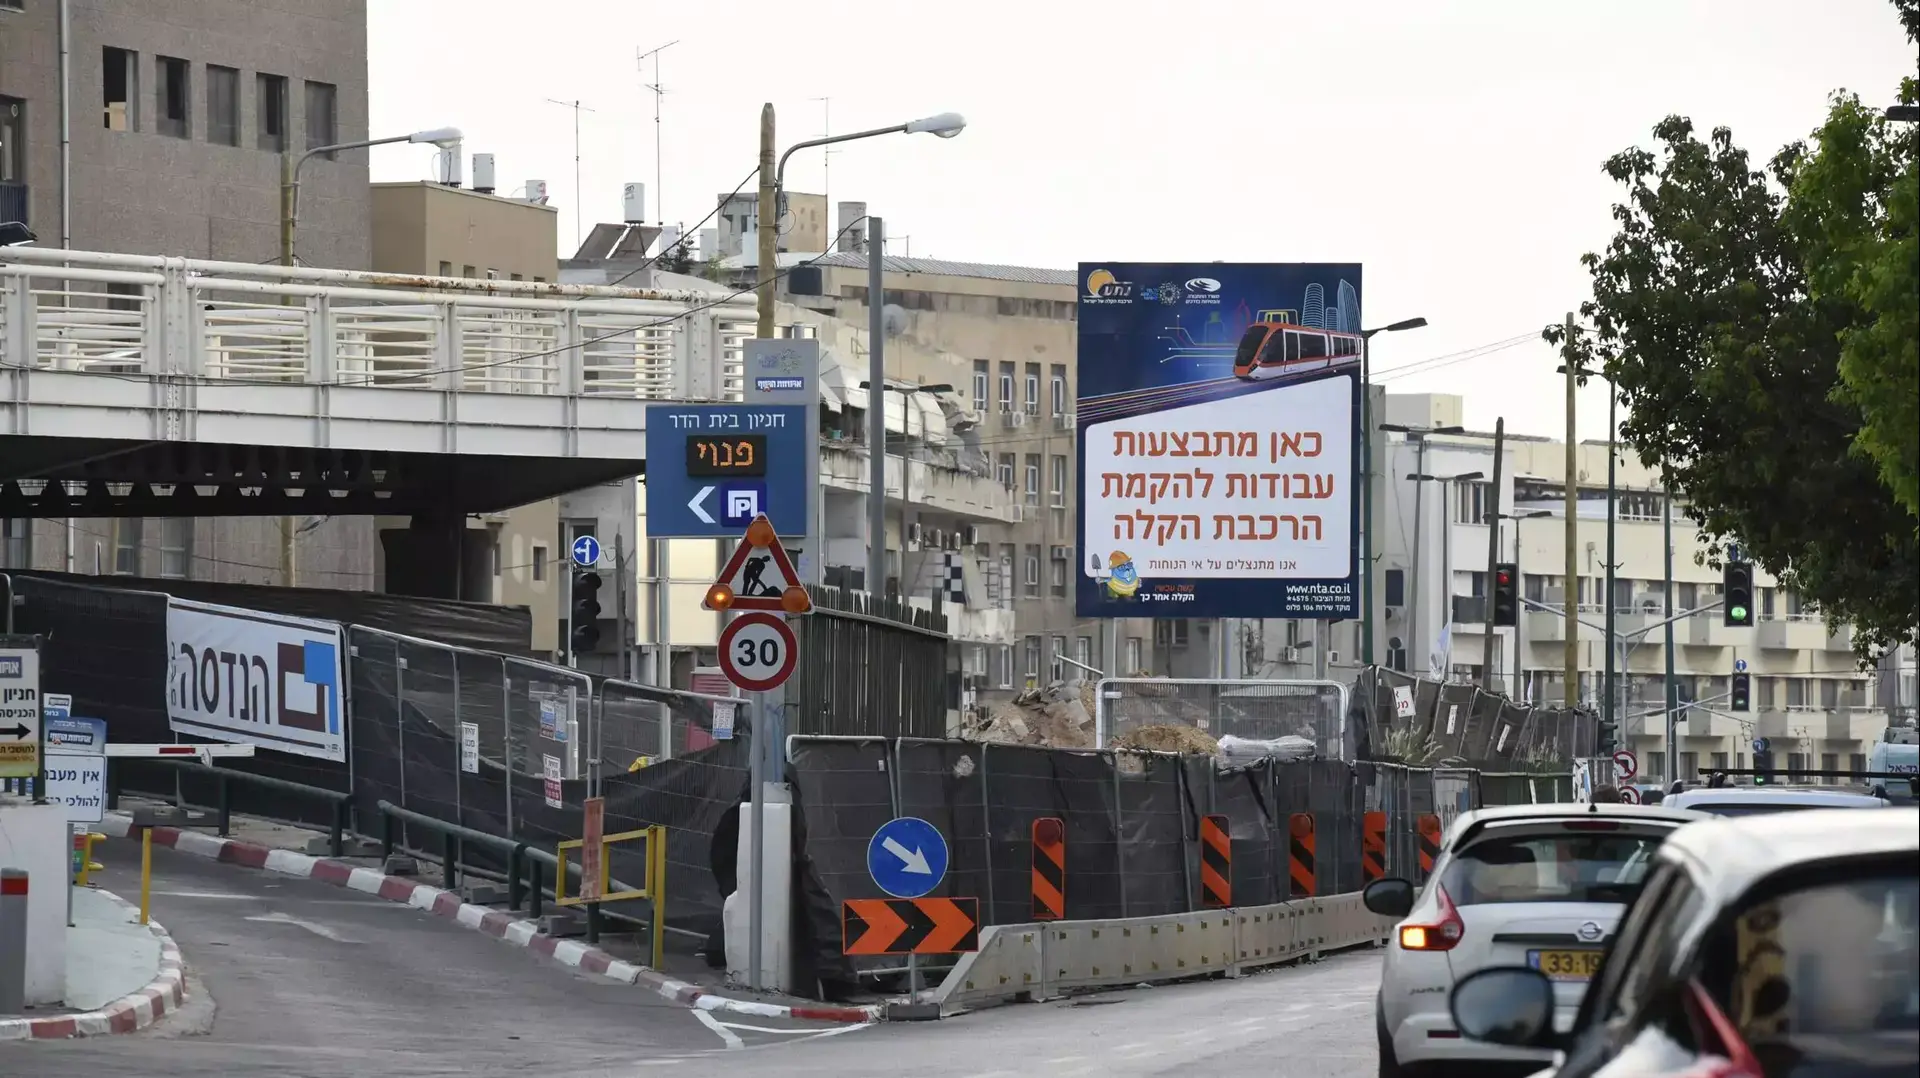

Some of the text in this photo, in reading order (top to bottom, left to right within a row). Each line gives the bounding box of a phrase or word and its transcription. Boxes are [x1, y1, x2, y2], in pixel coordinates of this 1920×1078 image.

[669, 413, 786, 430] חניון בית הדר
[697, 441, 754, 467] פנוי
[1113, 431, 1322, 463] כאן מתבצעות
[1101, 467, 1334, 504] עבודות להקמת
[1114, 508, 1322, 546] הרכבת הקלה
[1149, 558, 1296, 570] אנו מתנצלים על אי הנוחות
[1286, 582, 1351, 594] www.nta.co.il
[1140, 592, 1195, 602] הקלה אחר כך
[1335, 604, 1351, 612] מוקד
[737, 638, 779, 667] 30
[180, 642, 271, 725] הנדסה
[4, 688, 36, 704] חניון
[0, 709, 36, 718] הכניסה
[82, 770, 100, 784] אין
[66, 795, 100, 806] להולכי
